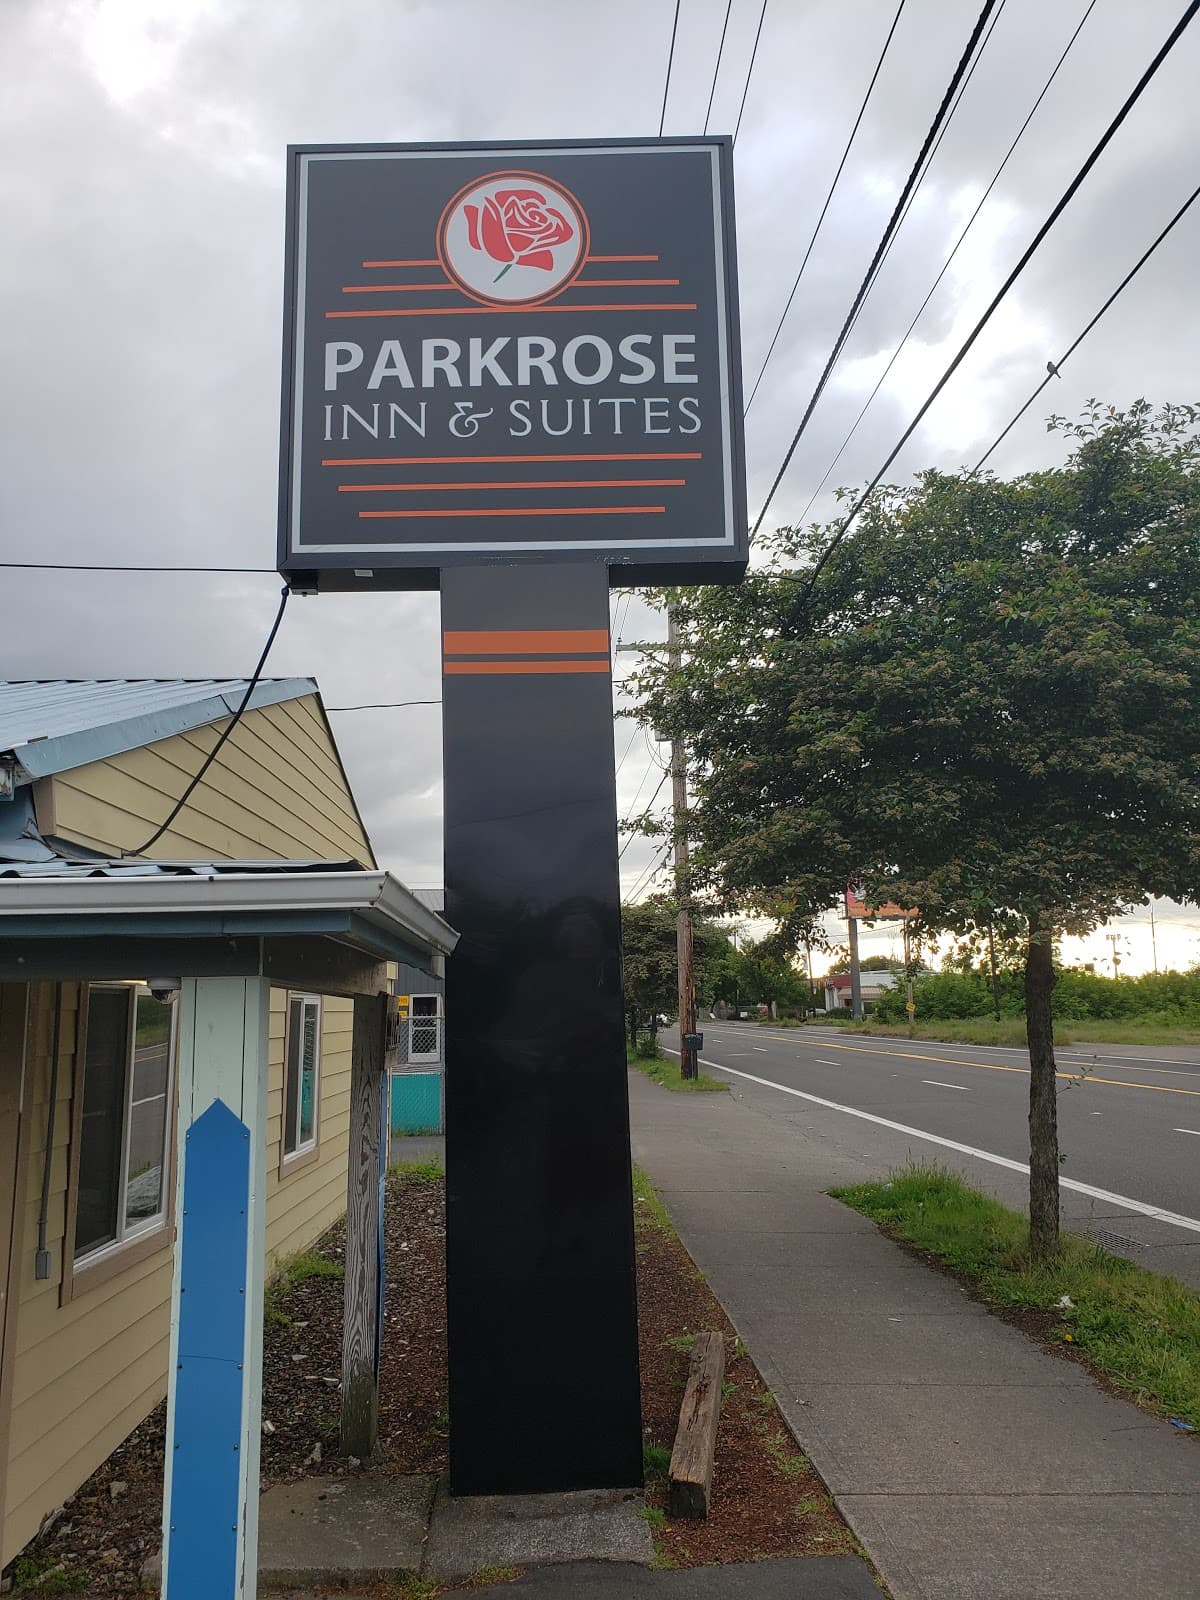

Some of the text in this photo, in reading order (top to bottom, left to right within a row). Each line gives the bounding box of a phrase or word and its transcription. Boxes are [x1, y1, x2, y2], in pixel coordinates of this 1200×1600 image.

[324, 334, 699, 391] PARKROSE
[323, 397, 702, 441] INN & SUITES
